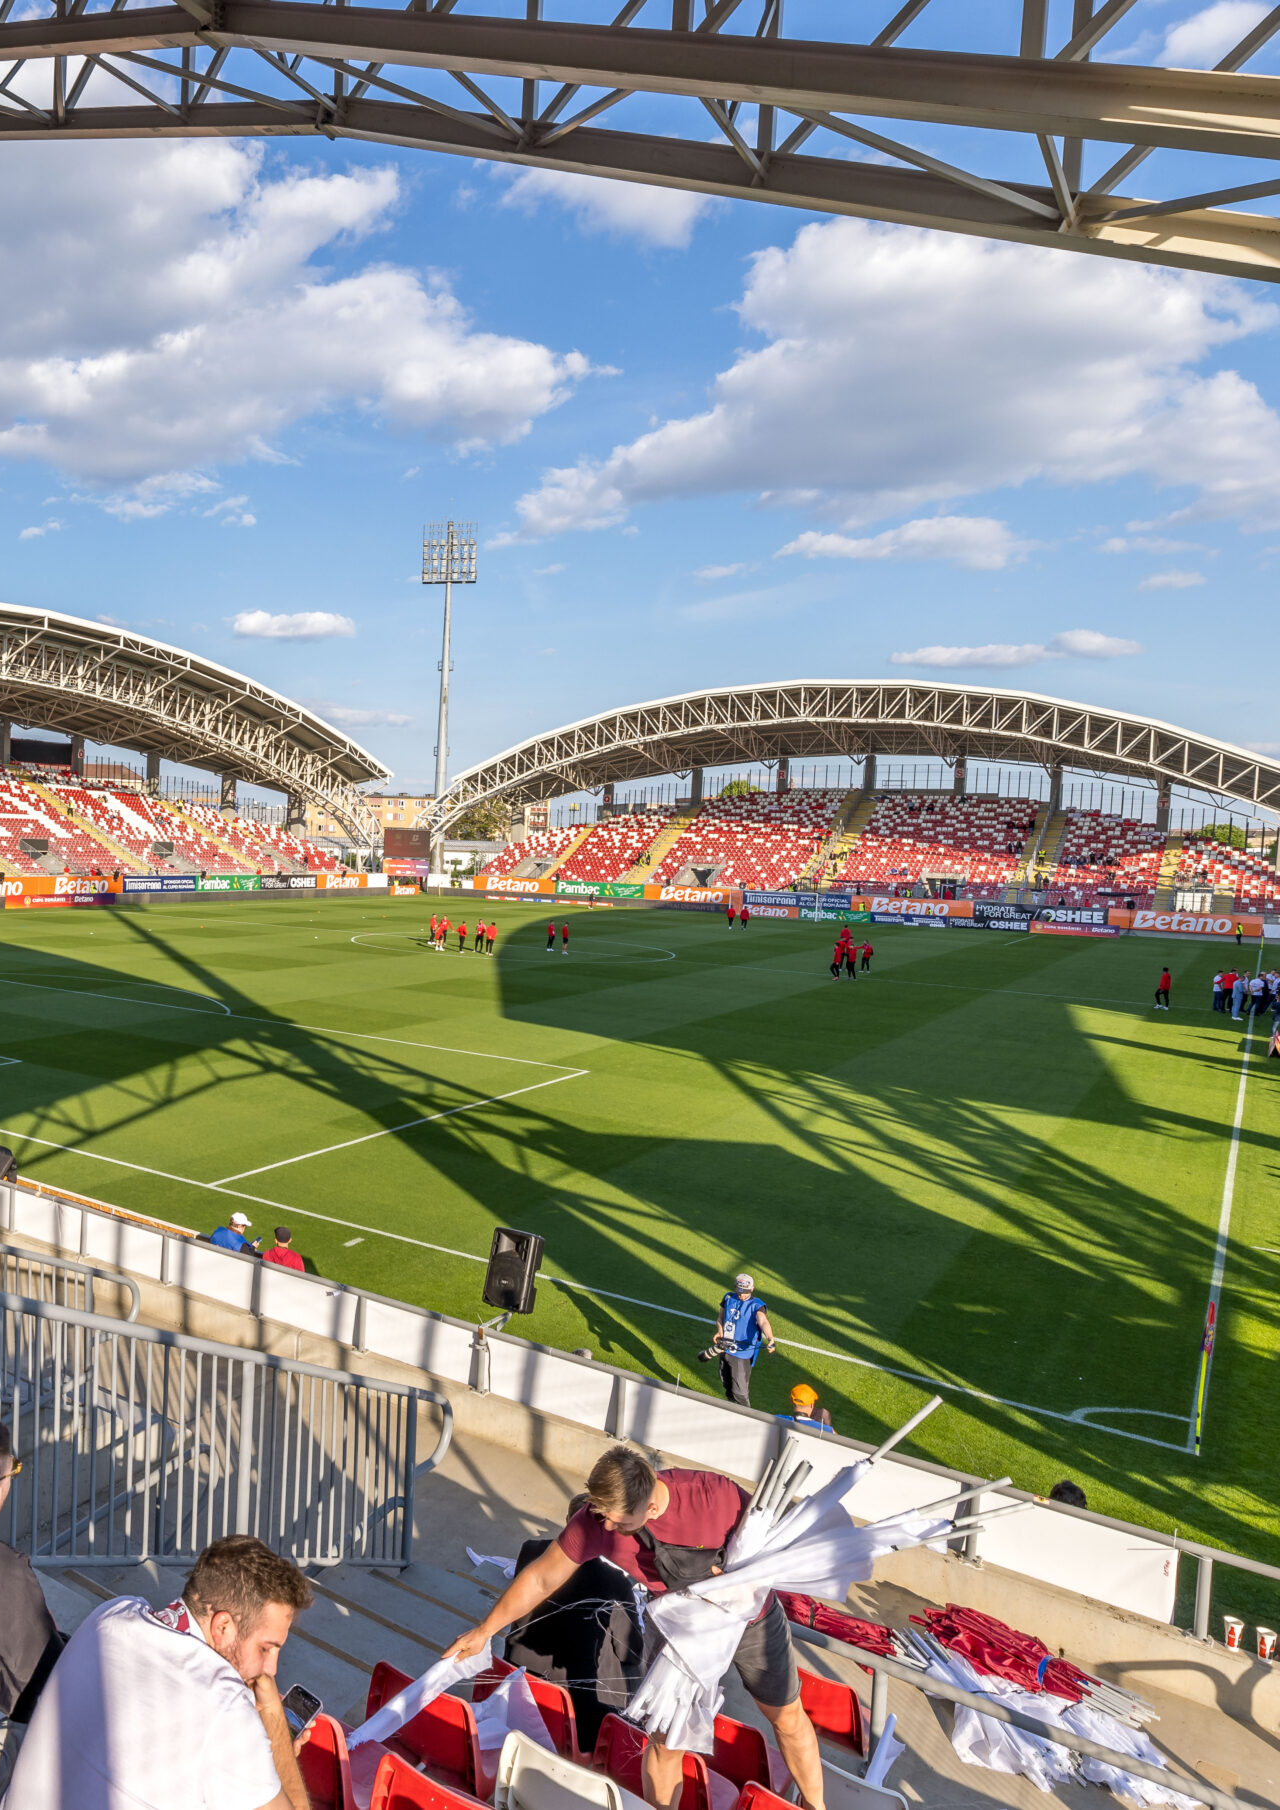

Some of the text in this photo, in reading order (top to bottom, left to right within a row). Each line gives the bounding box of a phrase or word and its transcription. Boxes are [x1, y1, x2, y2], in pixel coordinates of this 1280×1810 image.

[779, 771, 786, 779] R
[54, 876, 108, 895] Betano
[290, 876, 316, 888] OSHEE
[486, 877, 539, 893] Betano
[557, 881, 600, 895] Pambac
[660, 886, 723, 903] Betano
[871, 897, 949, 916] Betano
[984, 911, 1032, 920] FOR GREAT
[1042, 908, 1104, 924] OSHEE
[1133, 910, 1232, 933] Betano
[989, 920, 1028, 930] OSHEE
